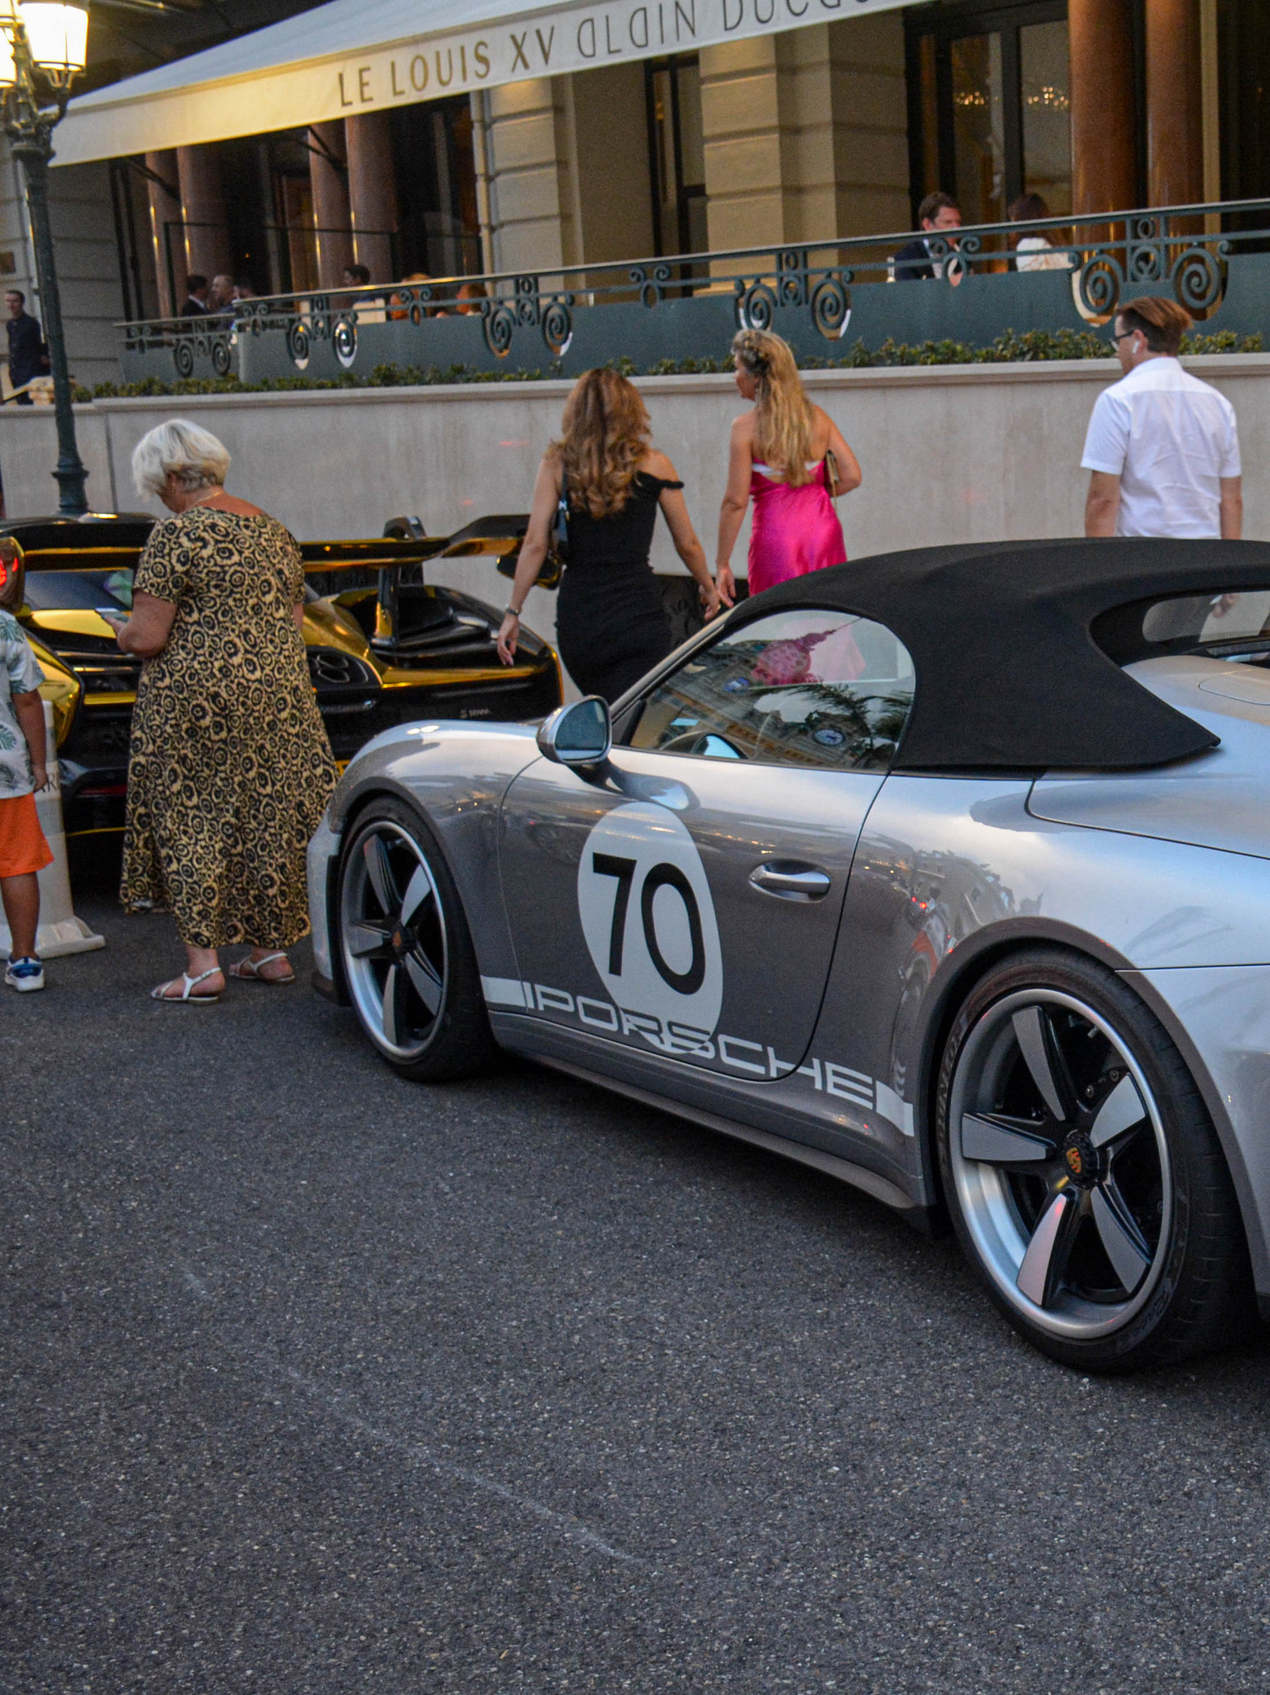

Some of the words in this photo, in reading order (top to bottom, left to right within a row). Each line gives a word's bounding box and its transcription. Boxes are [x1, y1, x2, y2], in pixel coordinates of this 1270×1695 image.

[338, 66, 374, 107] LE
[390, 41, 491, 97] LOUIS
[509, 25, 555, 73] XV
[592, 851, 707, 996] 70
[533, 982, 875, 1111] PORSCHE
